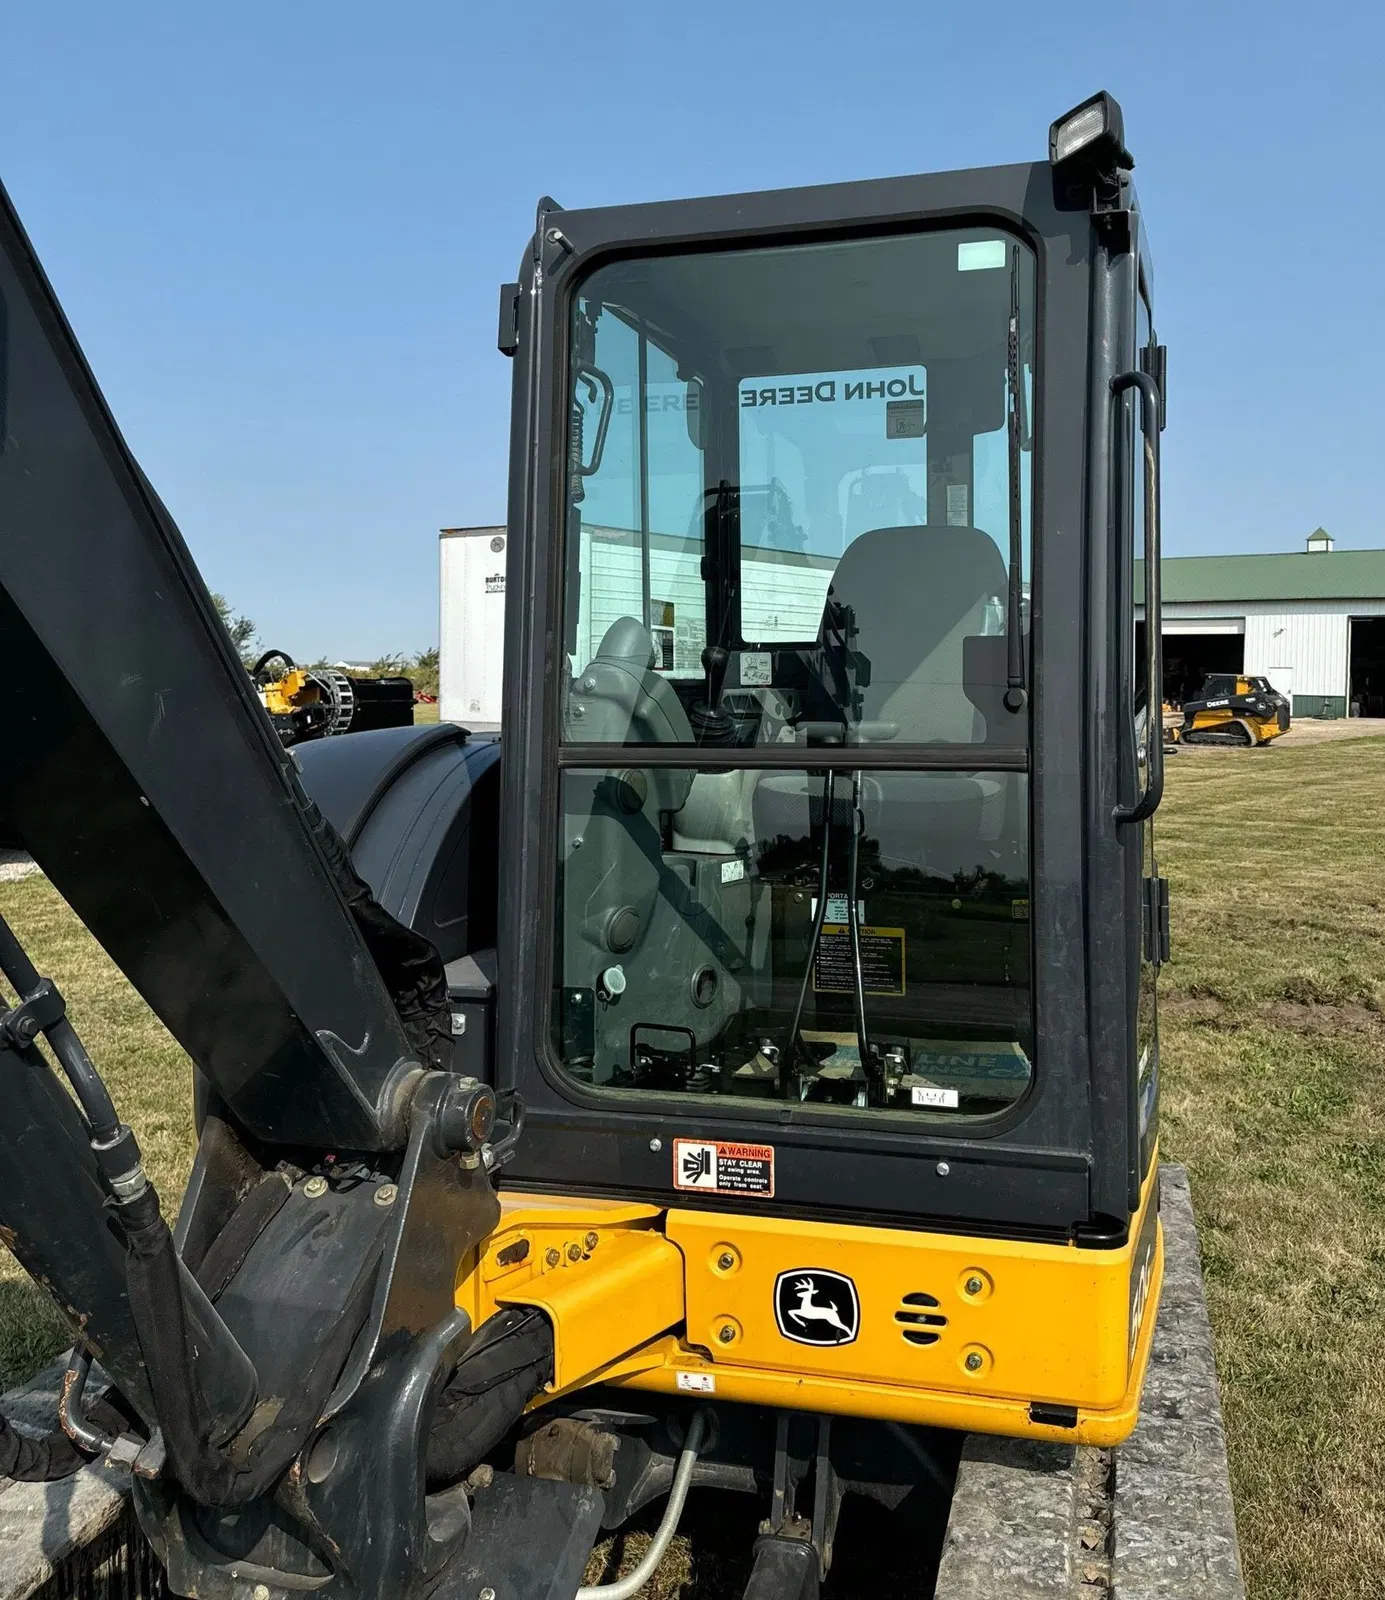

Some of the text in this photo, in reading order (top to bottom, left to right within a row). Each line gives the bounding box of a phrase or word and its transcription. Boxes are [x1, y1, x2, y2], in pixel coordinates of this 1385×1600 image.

[1206, 699, 1230, 708] DEERE
[728, 1147, 770, 1158] WARNING
[739, 1160, 762, 1168] CLEAR
[727, 1167, 745, 1175] swing
[719, 1174, 741, 1182] Operate
